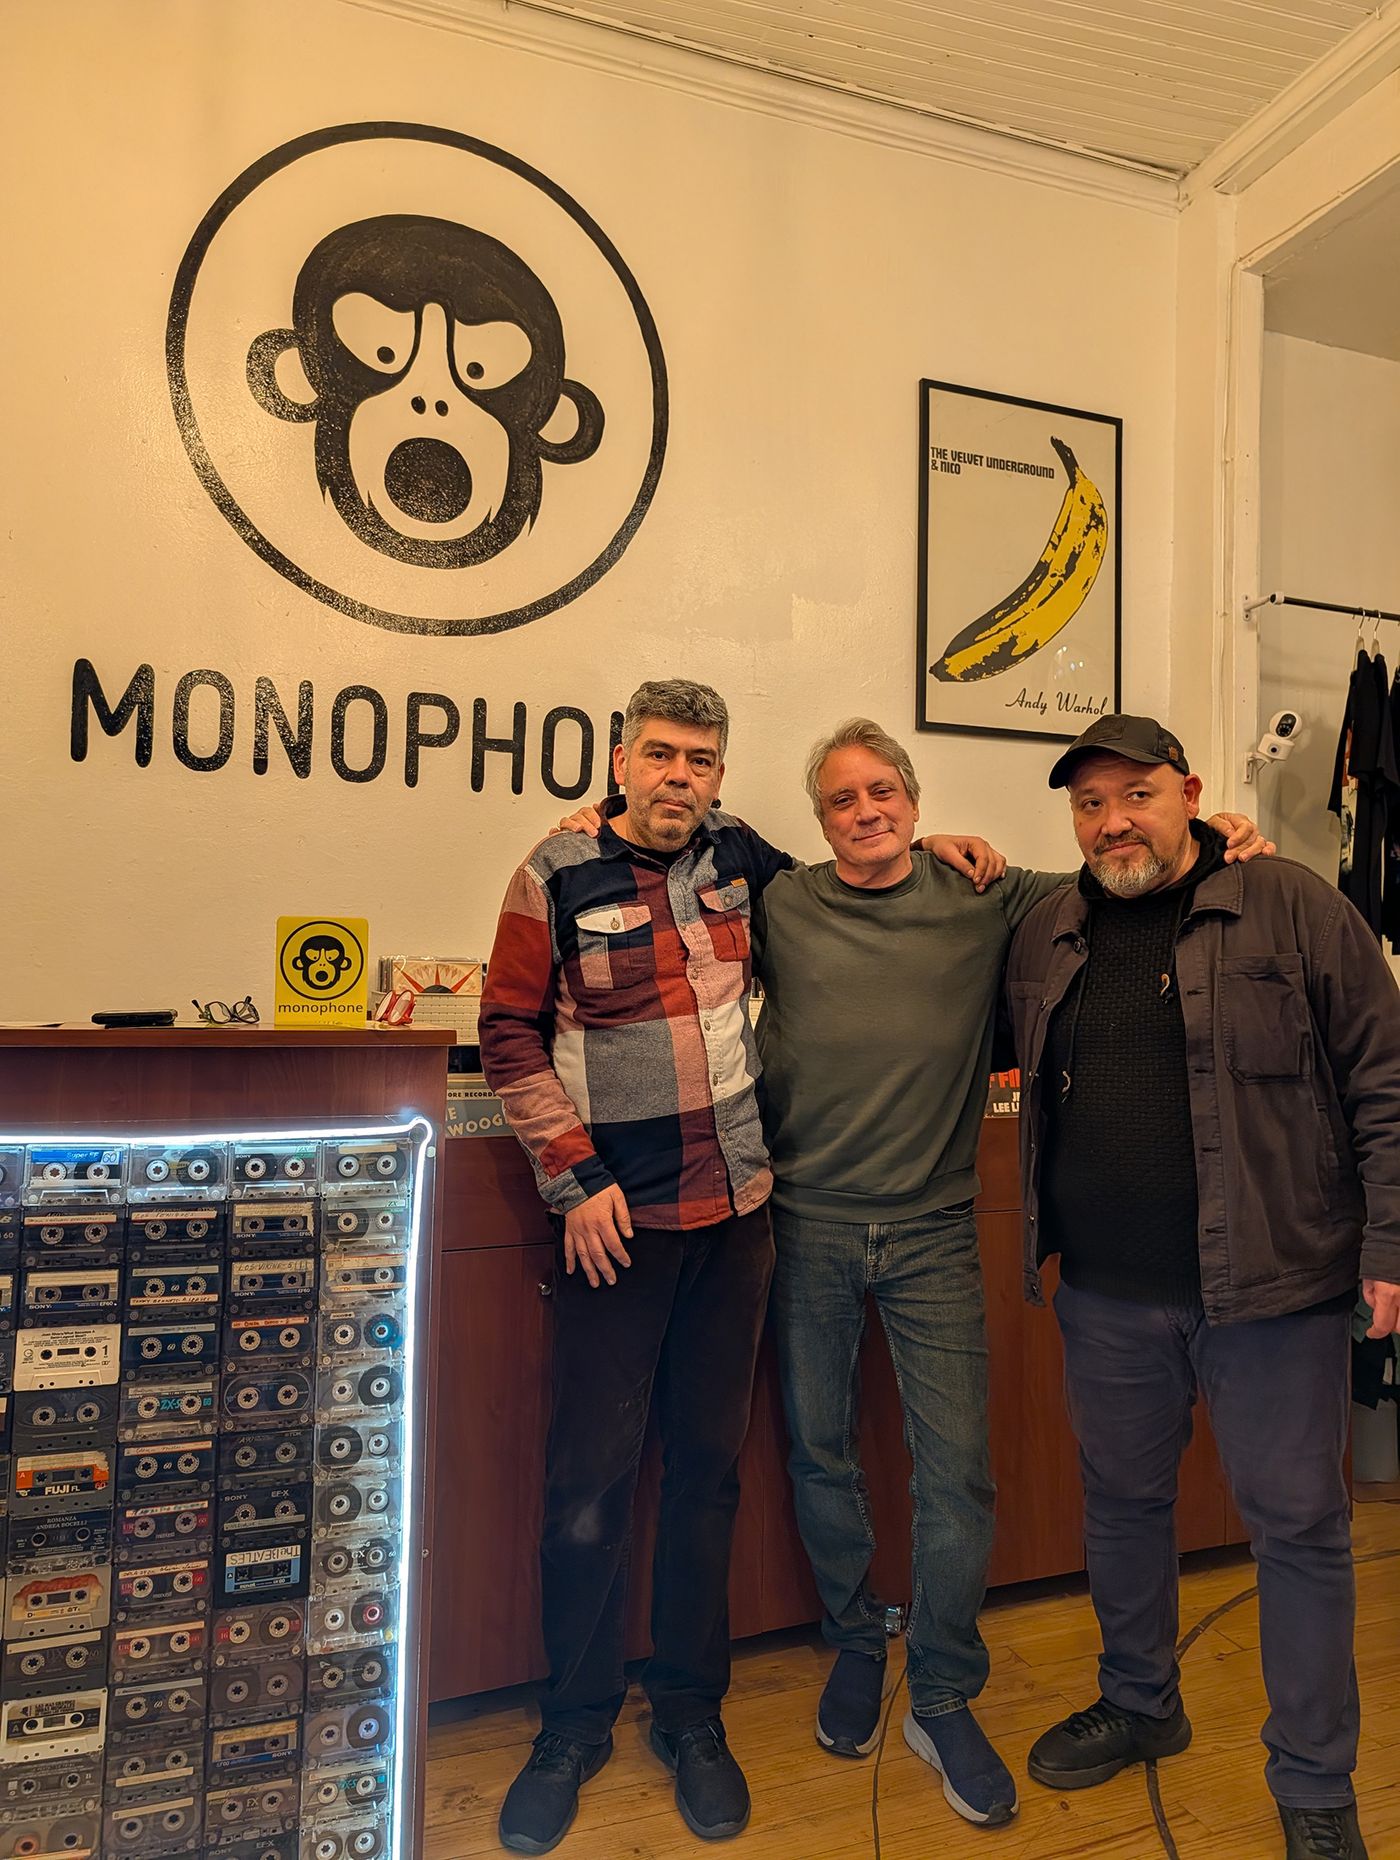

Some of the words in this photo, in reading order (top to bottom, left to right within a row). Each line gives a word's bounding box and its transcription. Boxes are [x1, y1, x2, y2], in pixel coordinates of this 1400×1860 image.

[930, 447, 948, 460] THE
[951, 450, 984, 467] VELVET
[986, 456, 1055, 479] UNDERGROUND
[931, 460, 939, 471] &
[940, 461, 961, 475] NICO
[1005, 688, 1048, 715] Andy
[1056, 692, 1107, 716] Warhol
[70, 658, 625, 800] MONOPHO
[278, 1003, 363, 1015] monophone
[993, 1102, 1010, 1113] LEE
[447, 1113, 503, 1137] WOOG
[3, 1231, 14, 1239] 60
[102, 1345, 109, 1356] 1
[44, 1484, 70, 1496] FUJI
